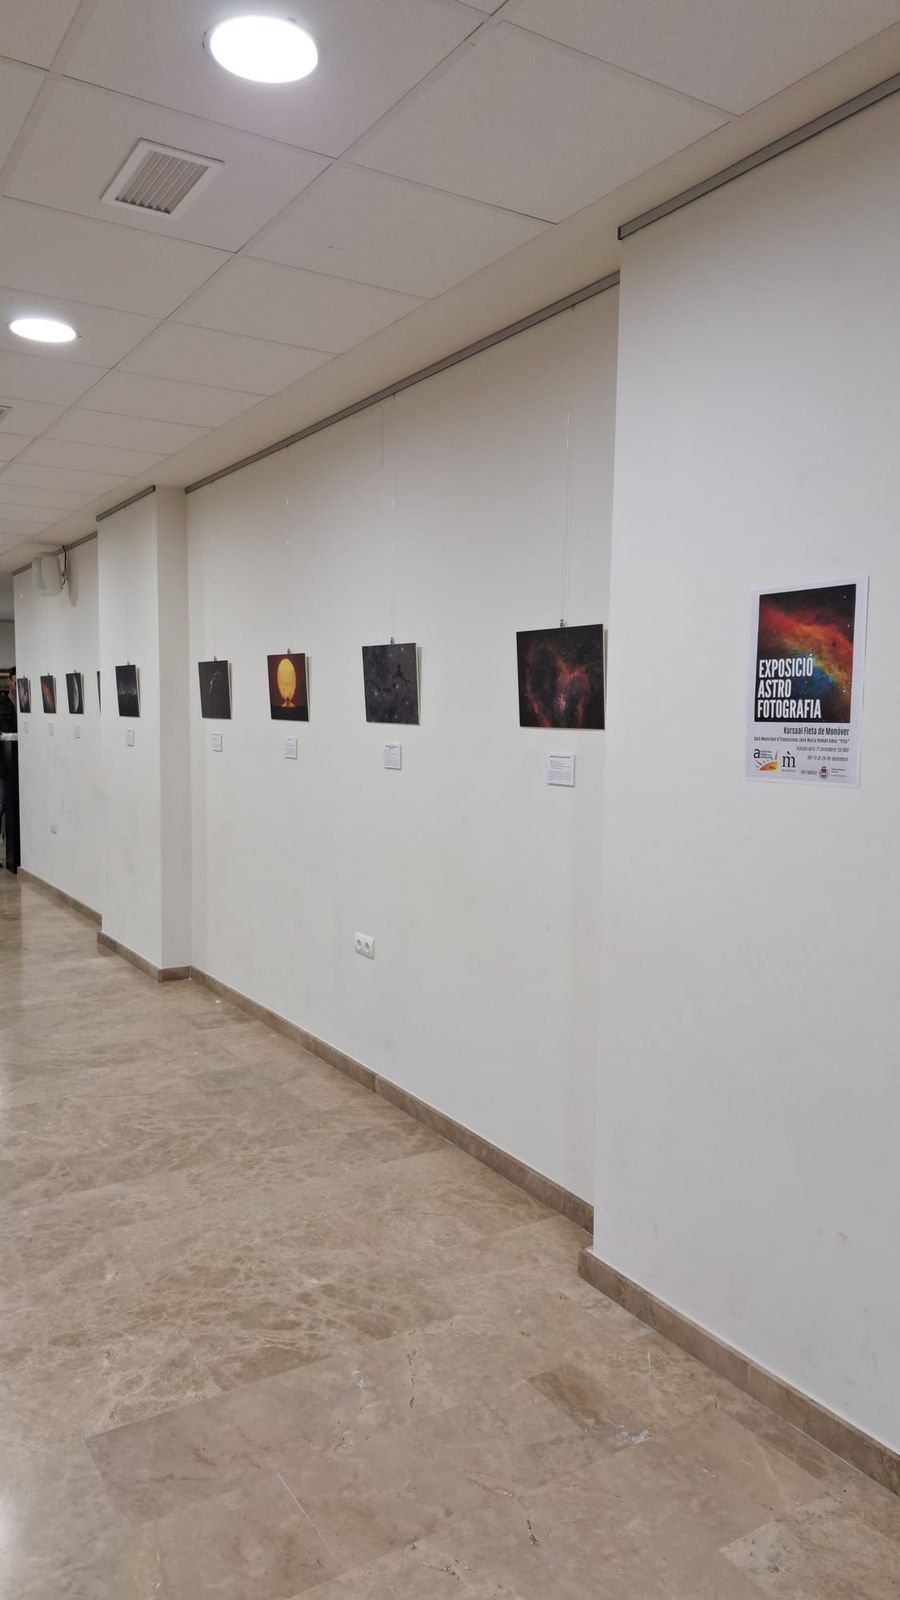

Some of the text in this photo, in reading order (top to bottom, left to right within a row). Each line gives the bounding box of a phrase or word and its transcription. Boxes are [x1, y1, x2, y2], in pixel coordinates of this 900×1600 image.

[759, 653, 813, 678] EXPOSICIÓ
[758, 679, 792, 698] ASTRO
[757, 699, 822, 718] FOTOGRAFIA
[783, 726, 803, 735] Kursaal
[804, 726, 817, 735] Fleta
[818, 727, 825, 735] de
